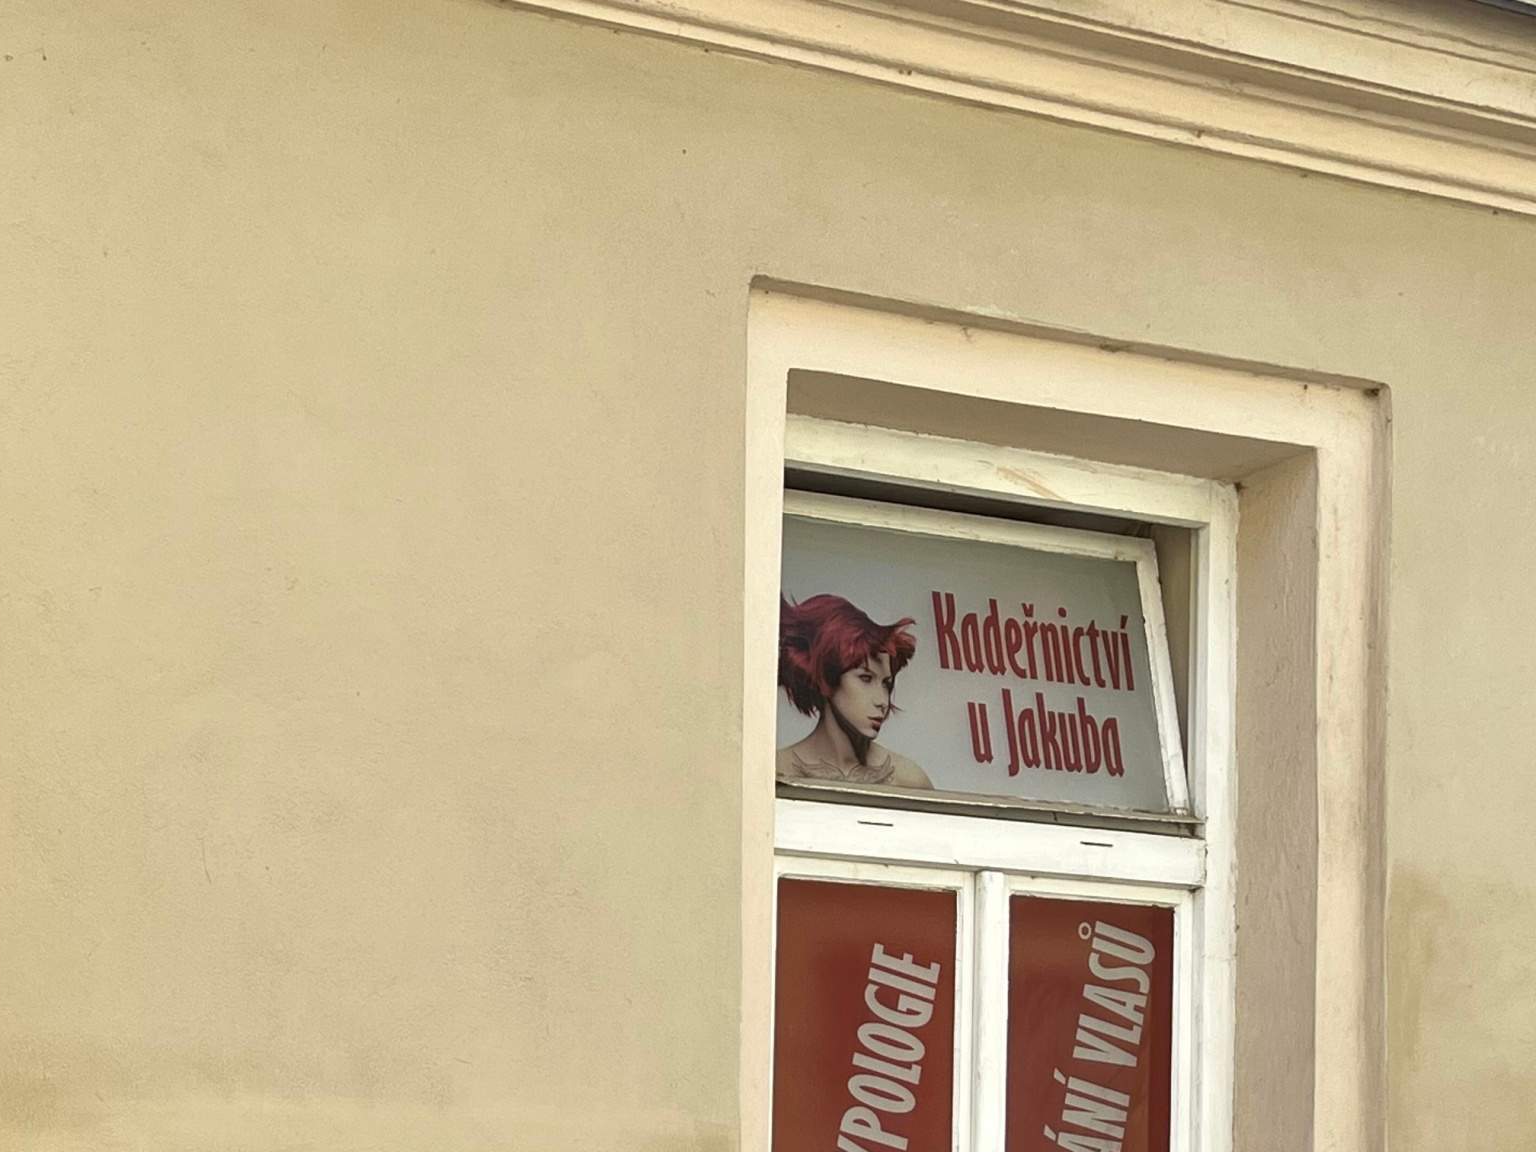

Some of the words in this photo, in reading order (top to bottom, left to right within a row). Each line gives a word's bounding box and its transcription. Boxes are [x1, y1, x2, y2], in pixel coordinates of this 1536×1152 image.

[932, 591, 1135, 691] Kadeřnictví
[967, 702, 993, 763] u
[1001, 688, 1124, 777] Jakuba
[1073, 919, 1157, 1069] VLASŮ
